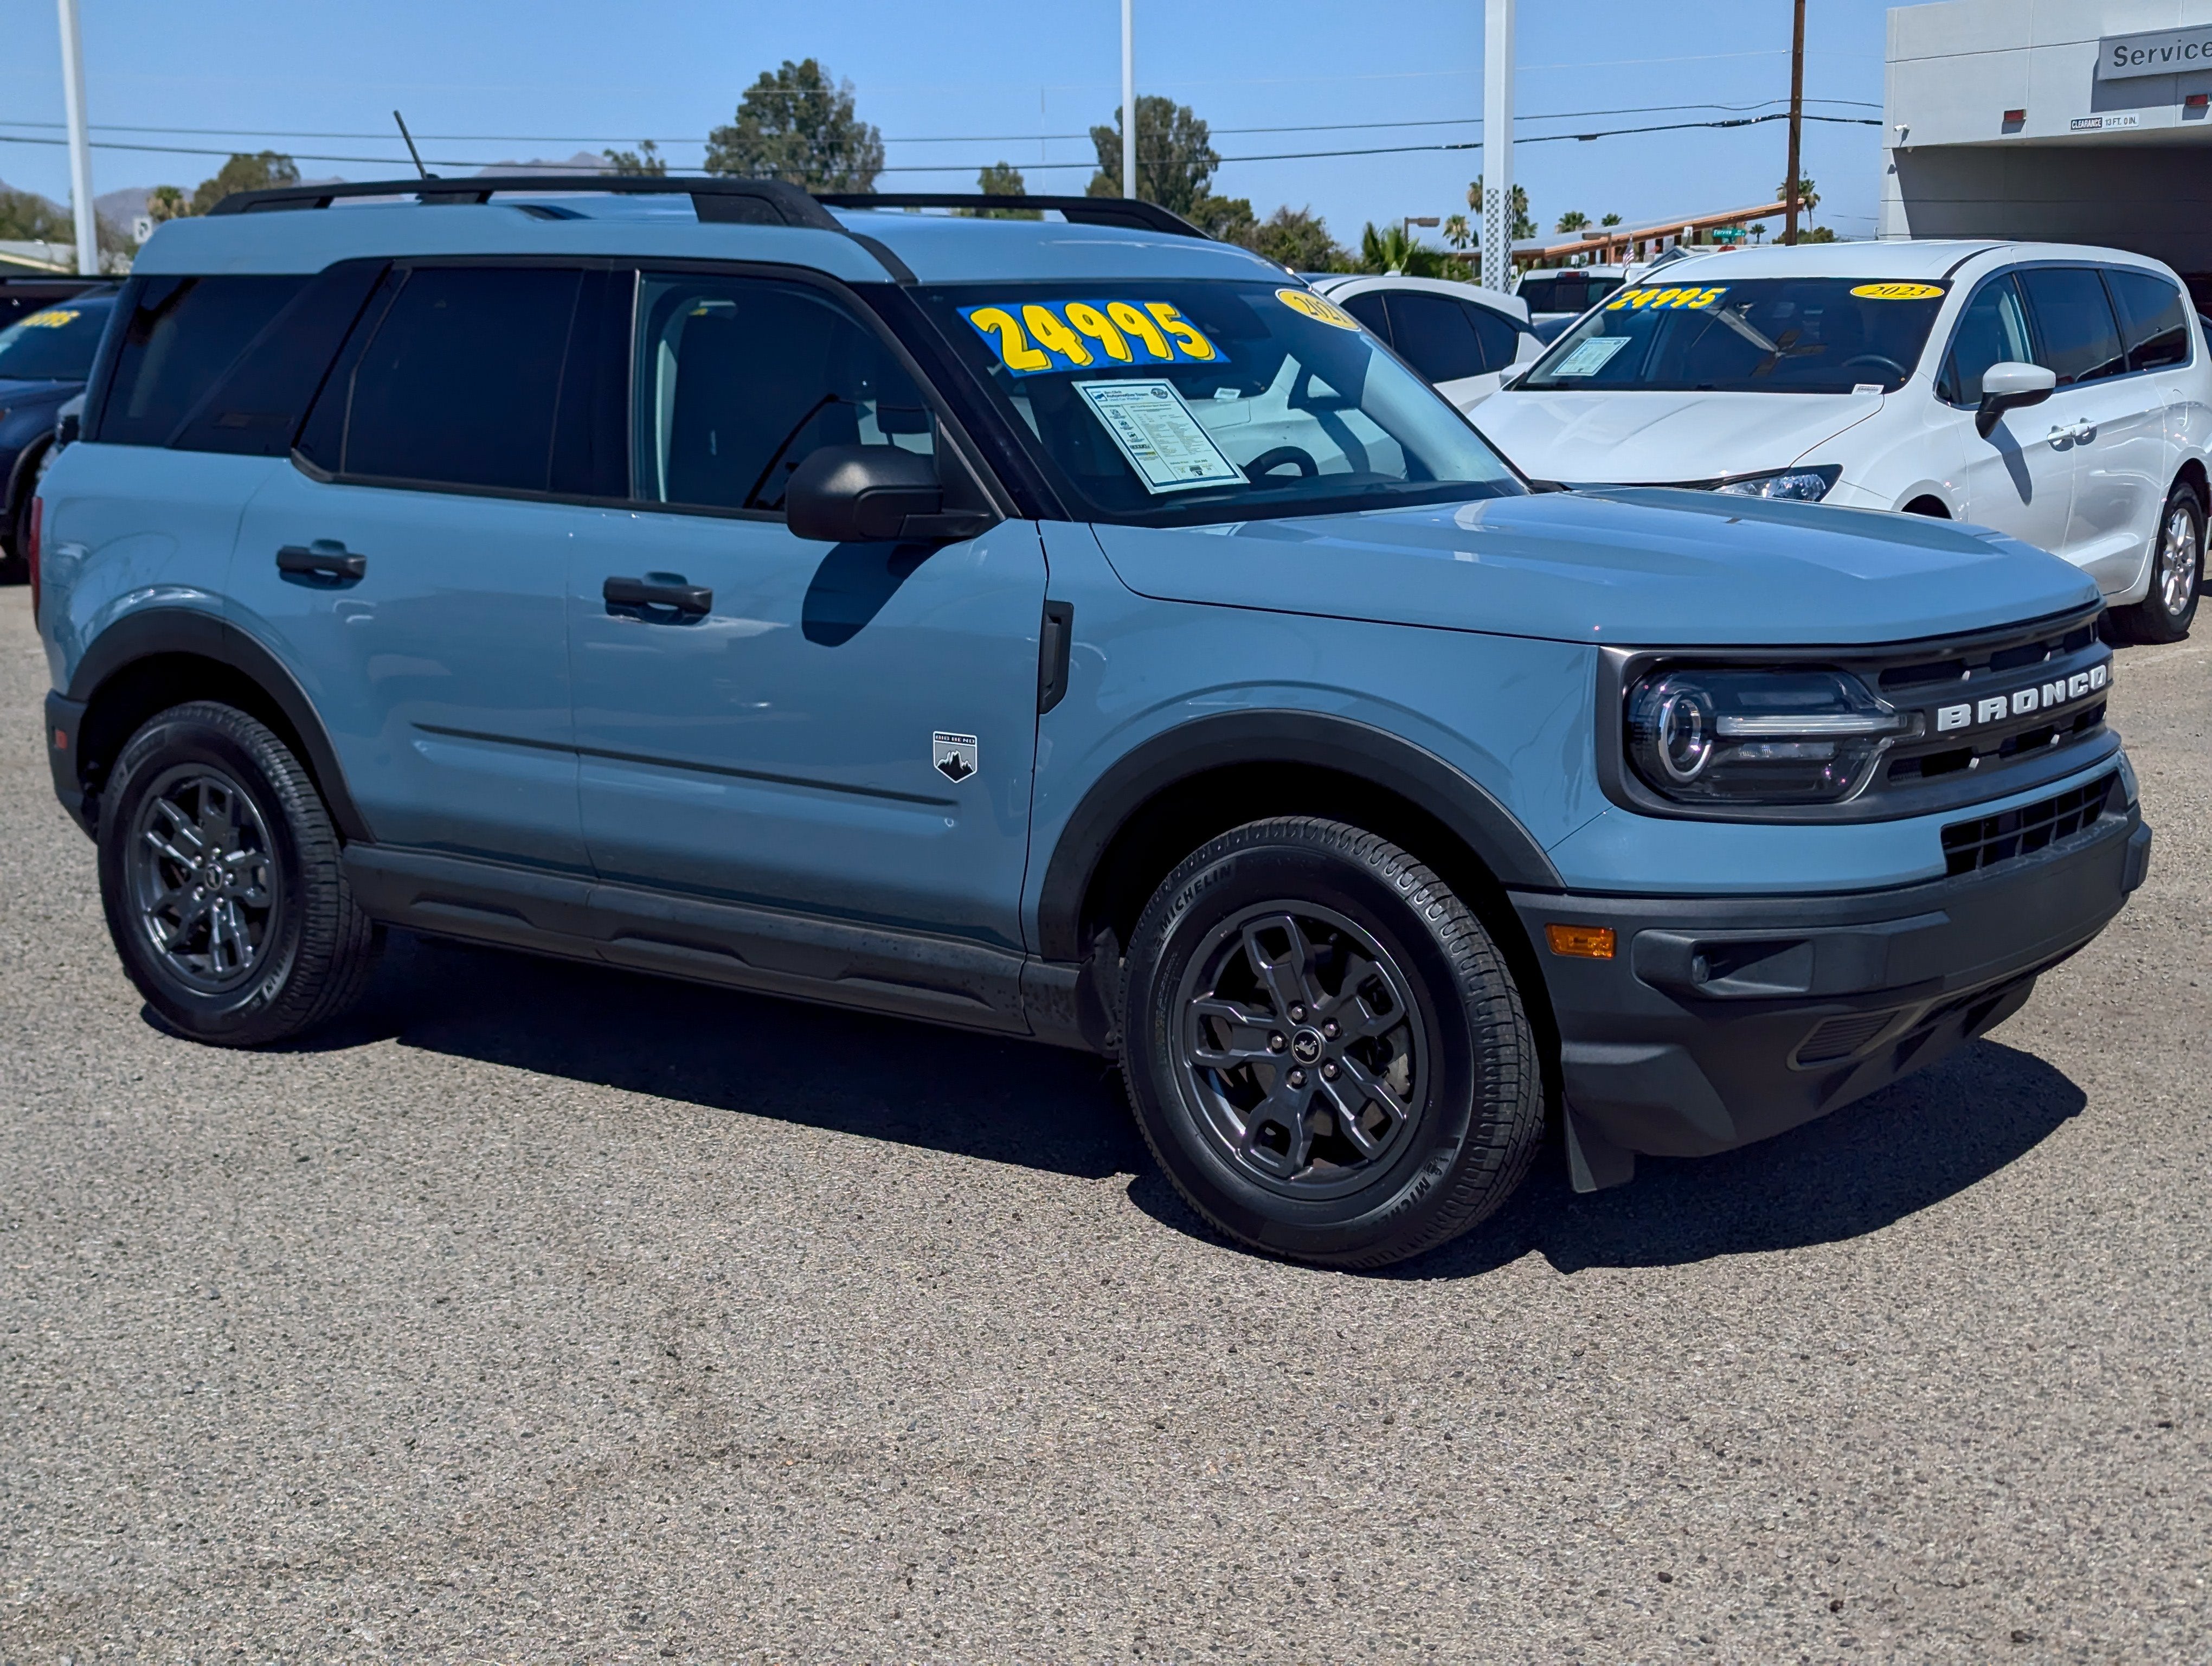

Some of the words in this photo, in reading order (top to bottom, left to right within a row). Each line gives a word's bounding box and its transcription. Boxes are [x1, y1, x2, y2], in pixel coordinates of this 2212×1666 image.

[2114, 39, 2212, 67] Service
[2072, 118, 2101, 129] CLEARANCE
[1605, 287, 1726, 310] 24995
[1865, 286, 1931, 296] 2023
[1293, 296, 1348, 323] 2021
[970, 302, 1216, 371] 24995
[1937, 664, 2107, 732] BRONCO
[1159, 864, 1232, 933] MICHELIN
